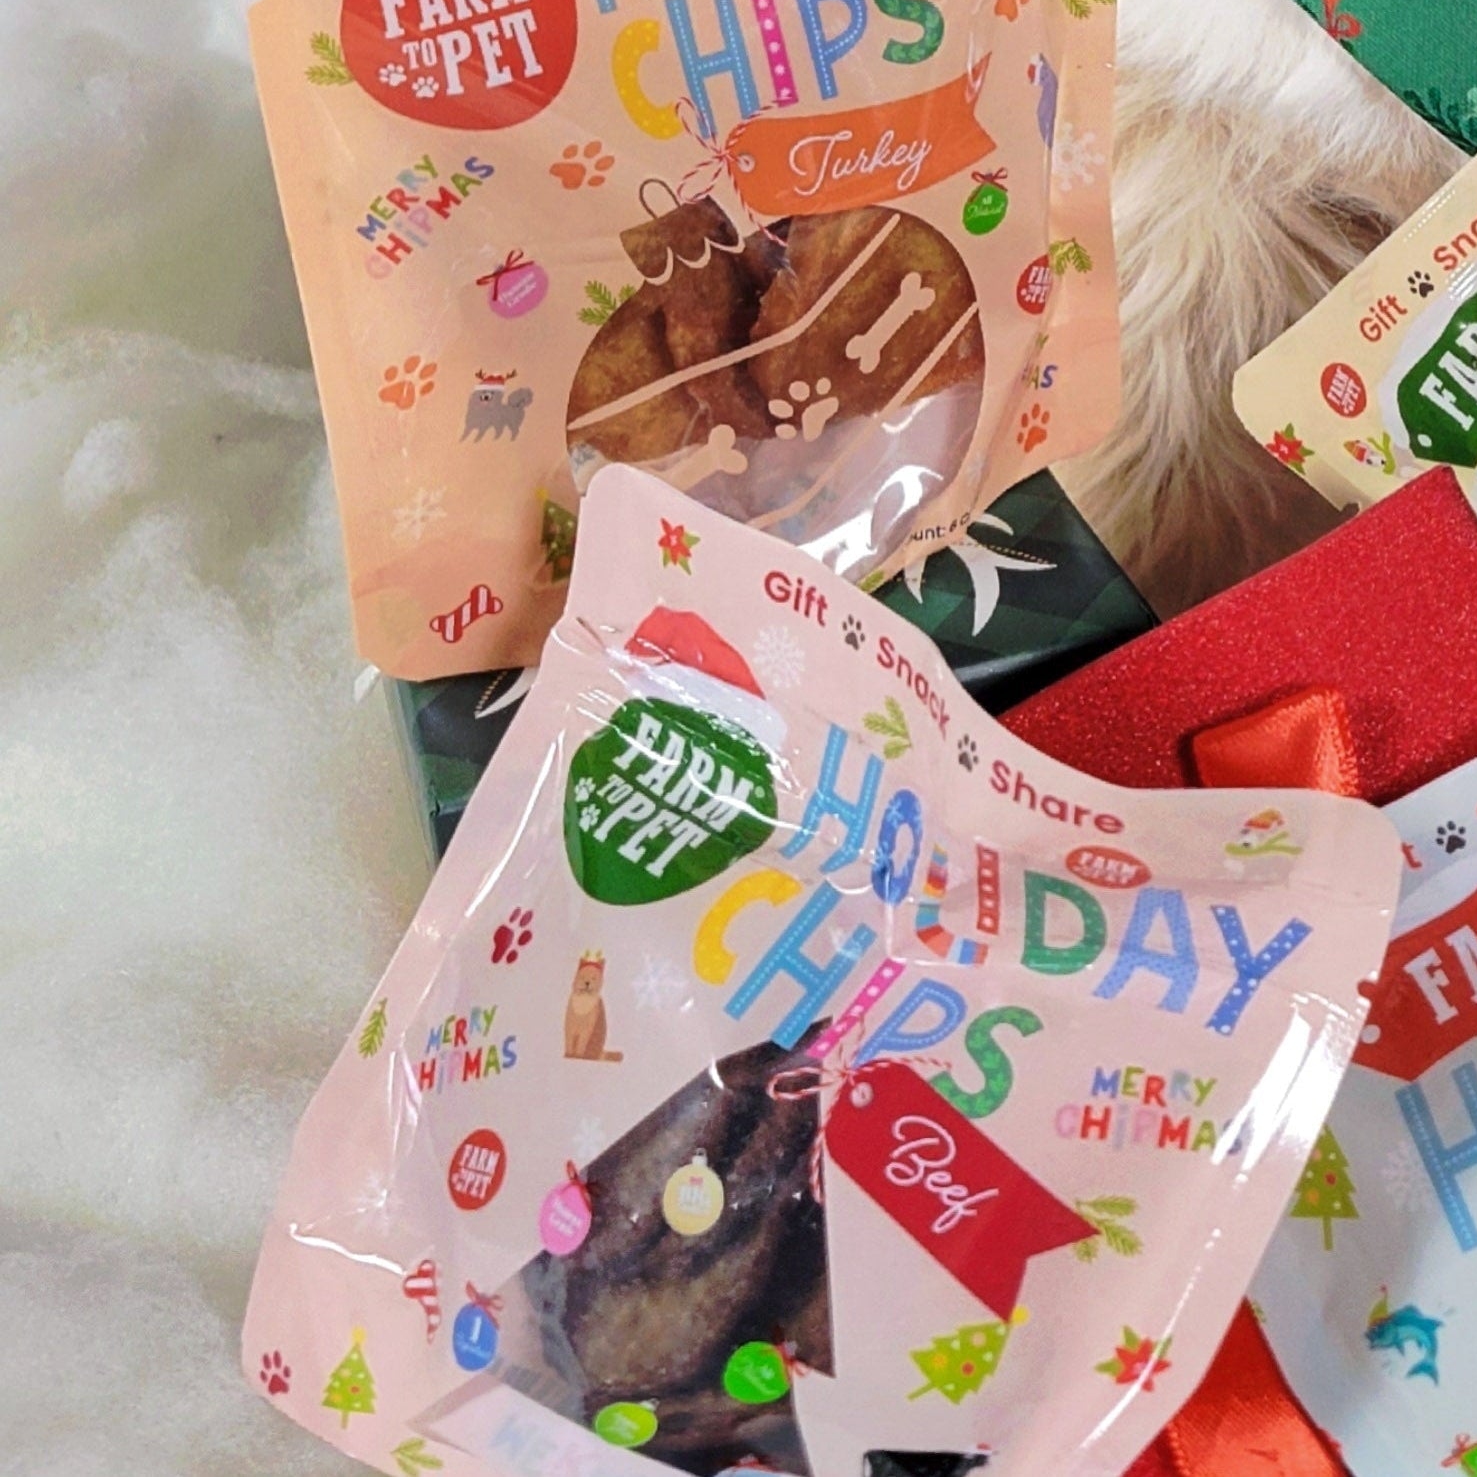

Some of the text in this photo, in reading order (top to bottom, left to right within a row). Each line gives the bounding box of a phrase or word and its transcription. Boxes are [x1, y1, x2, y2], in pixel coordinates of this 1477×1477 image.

[403, 8, 543, 96] TO PET
[357, 154, 438, 242] MERRY
[789, 129, 932, 196] Turkey
[1359, 294, 1408, 343] Gift
[763, 570, 1125, 835] Gift Snack Share
[596, 774, 634, 804] TO
[612, 712, 754, 833] FARM
[593, 791, 711, 879] PET
[779, 722, 1314, 1036] HOLIDAY
[426, 1004, 497, 1054] MERRY
[694, 869, 1043, 1120] CHIPS
[414, 1035, 518, 1094] HIPMAS
[1091, 1066, 1217, 1109] MERRY
[460, 1144, 500, 1177] FARM
[883, 1114, 999, 1234] Beef
